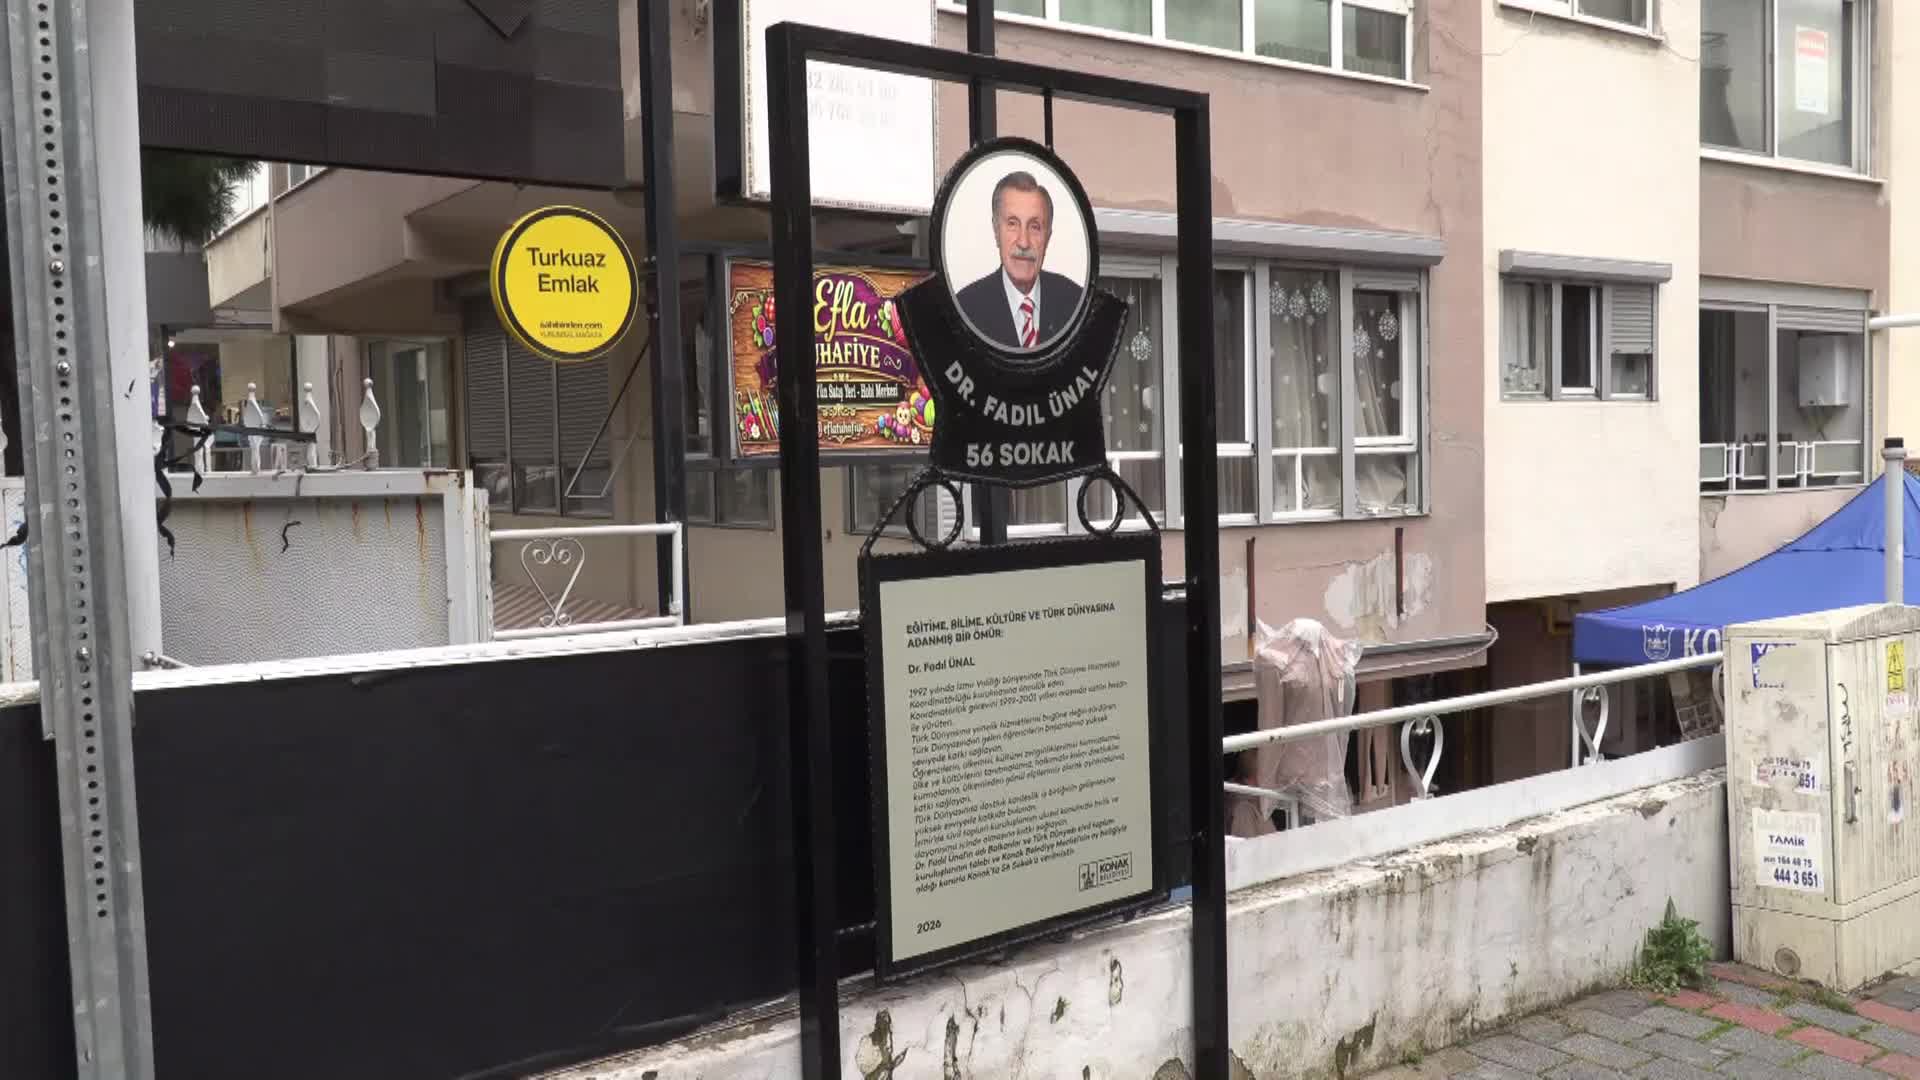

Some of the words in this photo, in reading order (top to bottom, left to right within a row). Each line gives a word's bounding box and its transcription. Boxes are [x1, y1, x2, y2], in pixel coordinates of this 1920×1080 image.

[526, 246, 608, 269] Turkuaz
[537, 272, 600, 294] Emlak
[814, 278, 871, 342] Efla
[816, 336, 881, 369] HAFİYE
[944, 360, 976, 407] DR.
[983, 395, 1046, 426] FADIL
[1048, 366, 1099, 418] ÜNAL
[966, 443, 994, 467] 56
[999, 440, 1075, 467] SOKAK
[985, 608, 1026, 625] KÜLTÜRE
[1028, 610, 1040, 620] VE
[1042, 605, 1065, 618] TÜRK
[1067, 599, 1115, 616] DÜNYASINA
[907, 633, 952, 650] ADANMIŞ
[955, 630, 970, 642] BİR
[908, 663, 921, 674] Dr.
[923, 659, 946, 672] Fadıl
[948, 653, 975, 668] ÜNAL
[1768, 834, 1805, 847] TAMİR
[1099, 857, 1128, 873] KONAK
[1773, 867, 1791, 883] 444
[1793, 869, 1799, 884] 3
[1801, 870, 1818, 887] 651
